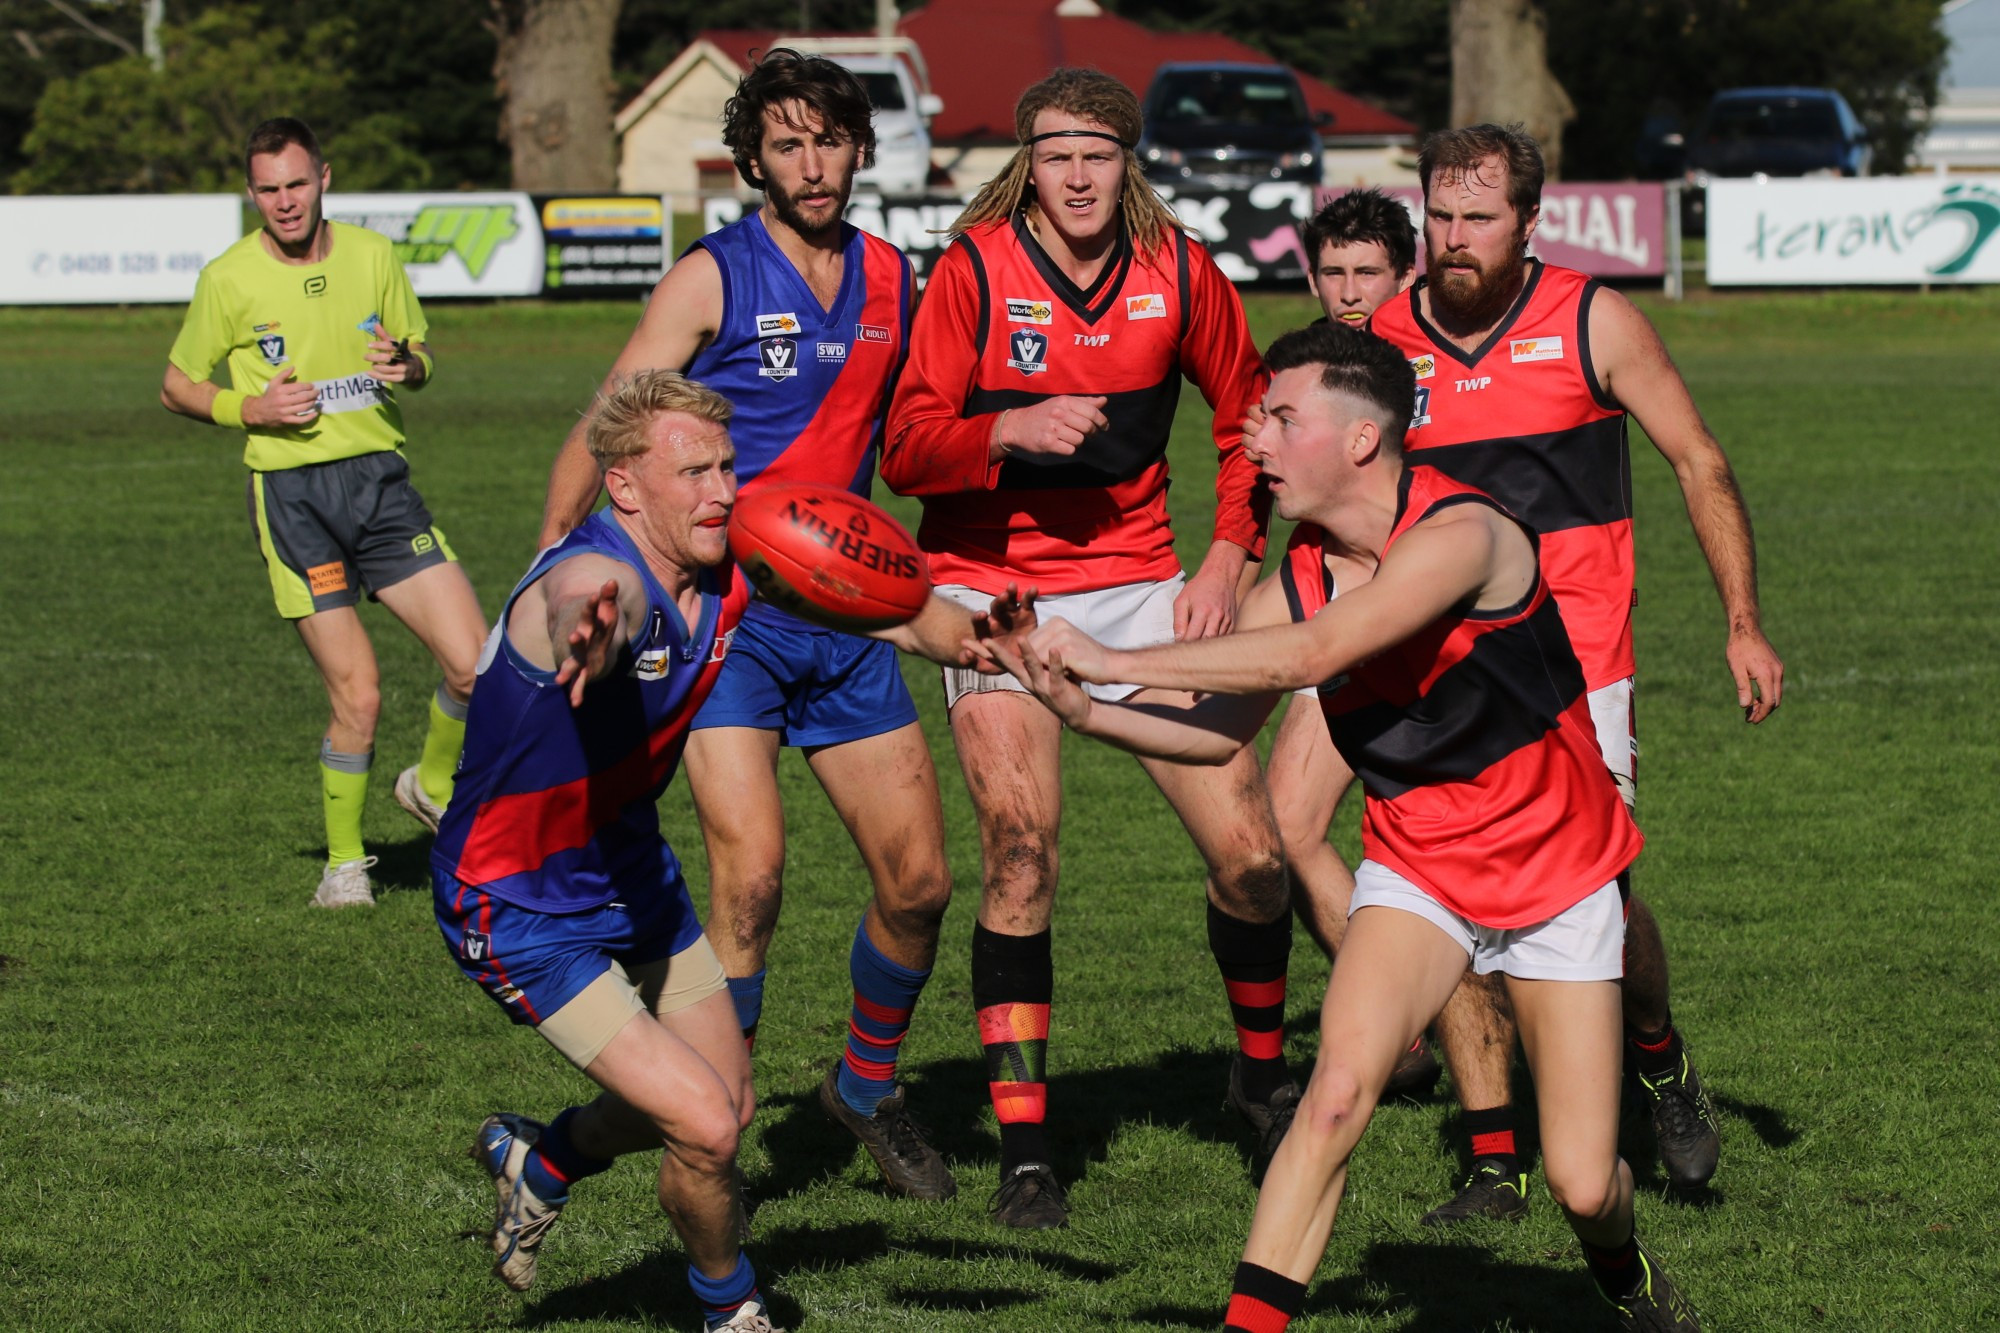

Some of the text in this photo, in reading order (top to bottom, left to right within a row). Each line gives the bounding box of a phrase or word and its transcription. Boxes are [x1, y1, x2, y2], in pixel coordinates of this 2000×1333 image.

[865, 329, 888, 339] RIDLEY
[1073, 333, 1111, 347] TWP
[819, 344, 844, 356] SWD
[1015, 361, 1039, 370] COUNTRY
[1454, 376, 1492, 393] TWP
[778, 498, 920, 580] SHERRIN
